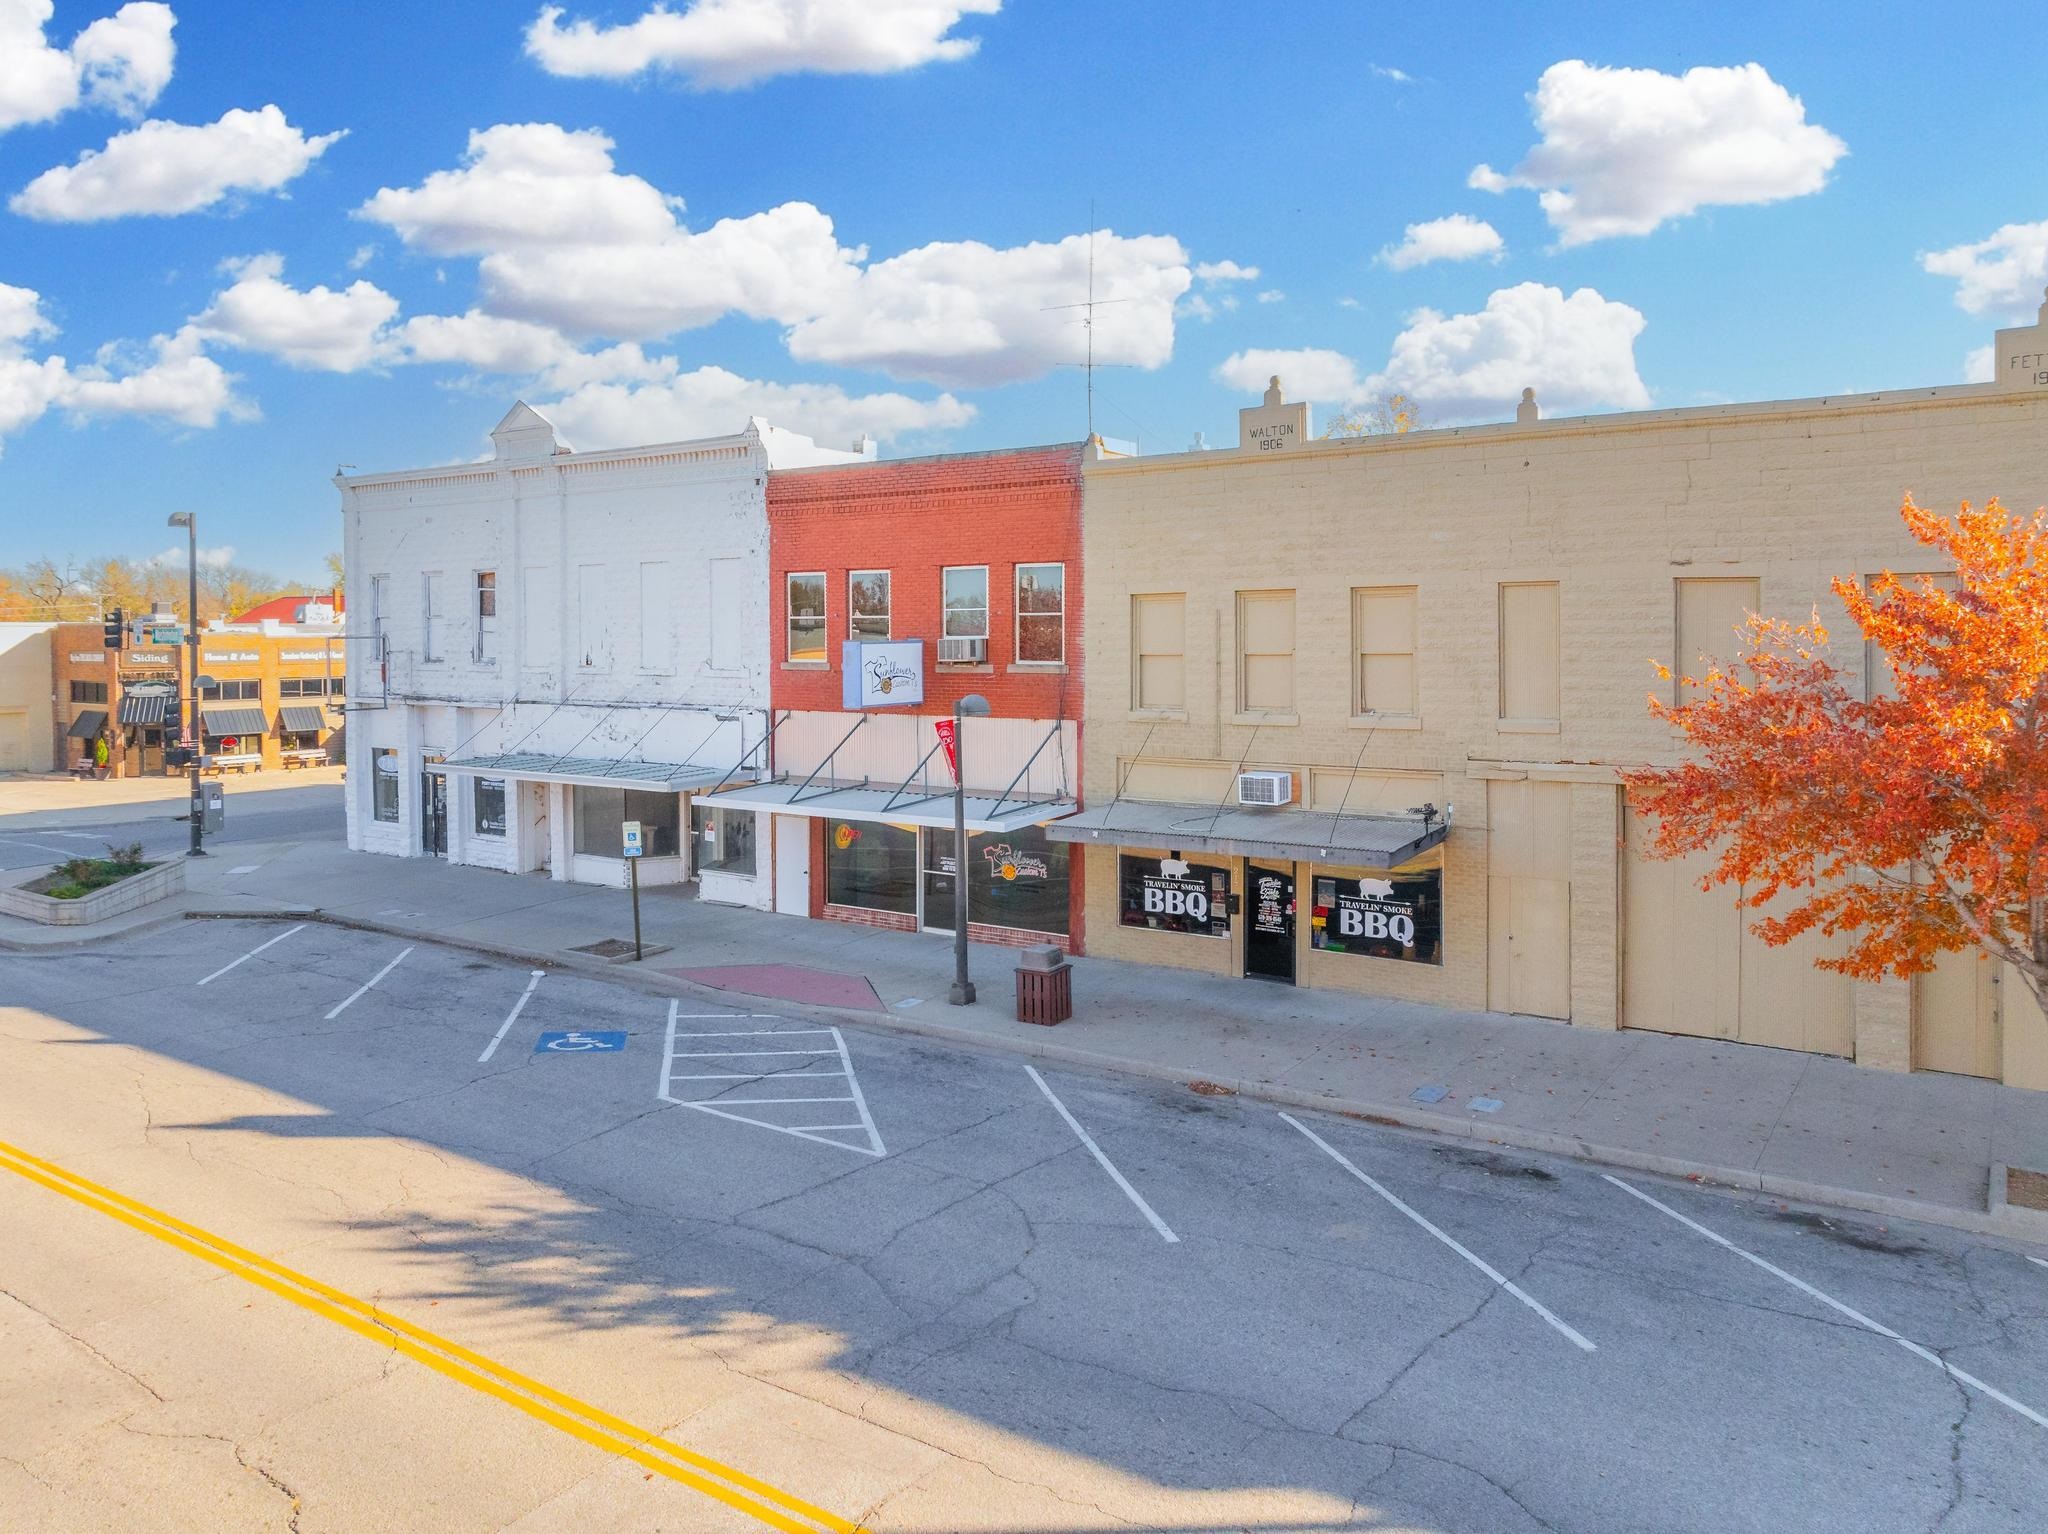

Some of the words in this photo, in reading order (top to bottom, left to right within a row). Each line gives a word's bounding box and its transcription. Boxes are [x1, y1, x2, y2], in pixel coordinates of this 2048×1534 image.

[2011, 353, 2048, 370] FET
[1249, 424, 1294, 438] WALTON
[1260, 439, 1283, 451] 1906
[131, 653, 169, 663] Siding
[1144, 880, 1180, 889] TRAVELIN'
[1180, 884, 1206, 892] SMOKE
[1144, 887, 1207, 922] BBQ
[1340, 900, 1382, 911] TRAVELIN'
[1382, 905, 1413, 915] SMOKE
[1340, 908, 1414, 947] BBQ
